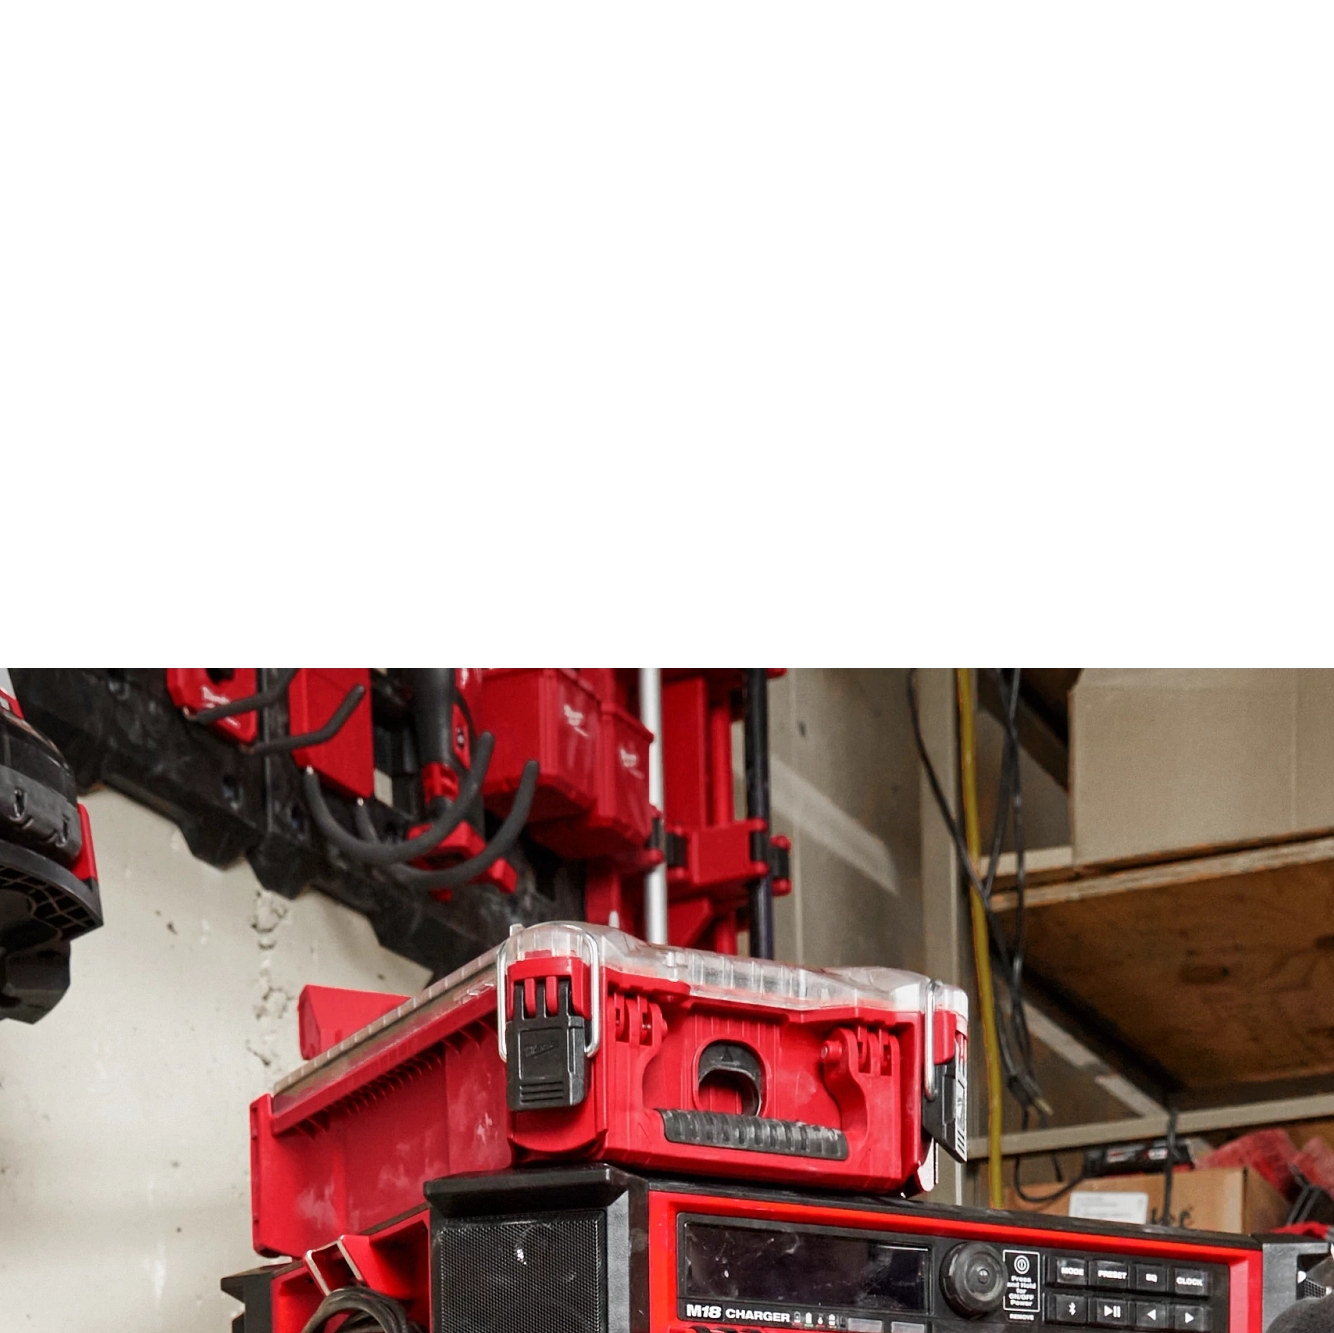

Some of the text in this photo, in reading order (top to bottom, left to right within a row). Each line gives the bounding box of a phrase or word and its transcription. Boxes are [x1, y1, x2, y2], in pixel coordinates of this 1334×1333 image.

[1061, 1267, 1203, 1287] MODE PRESET EQ CLOCK
[686, 1304, 791, 1323] M18 CHARGER
